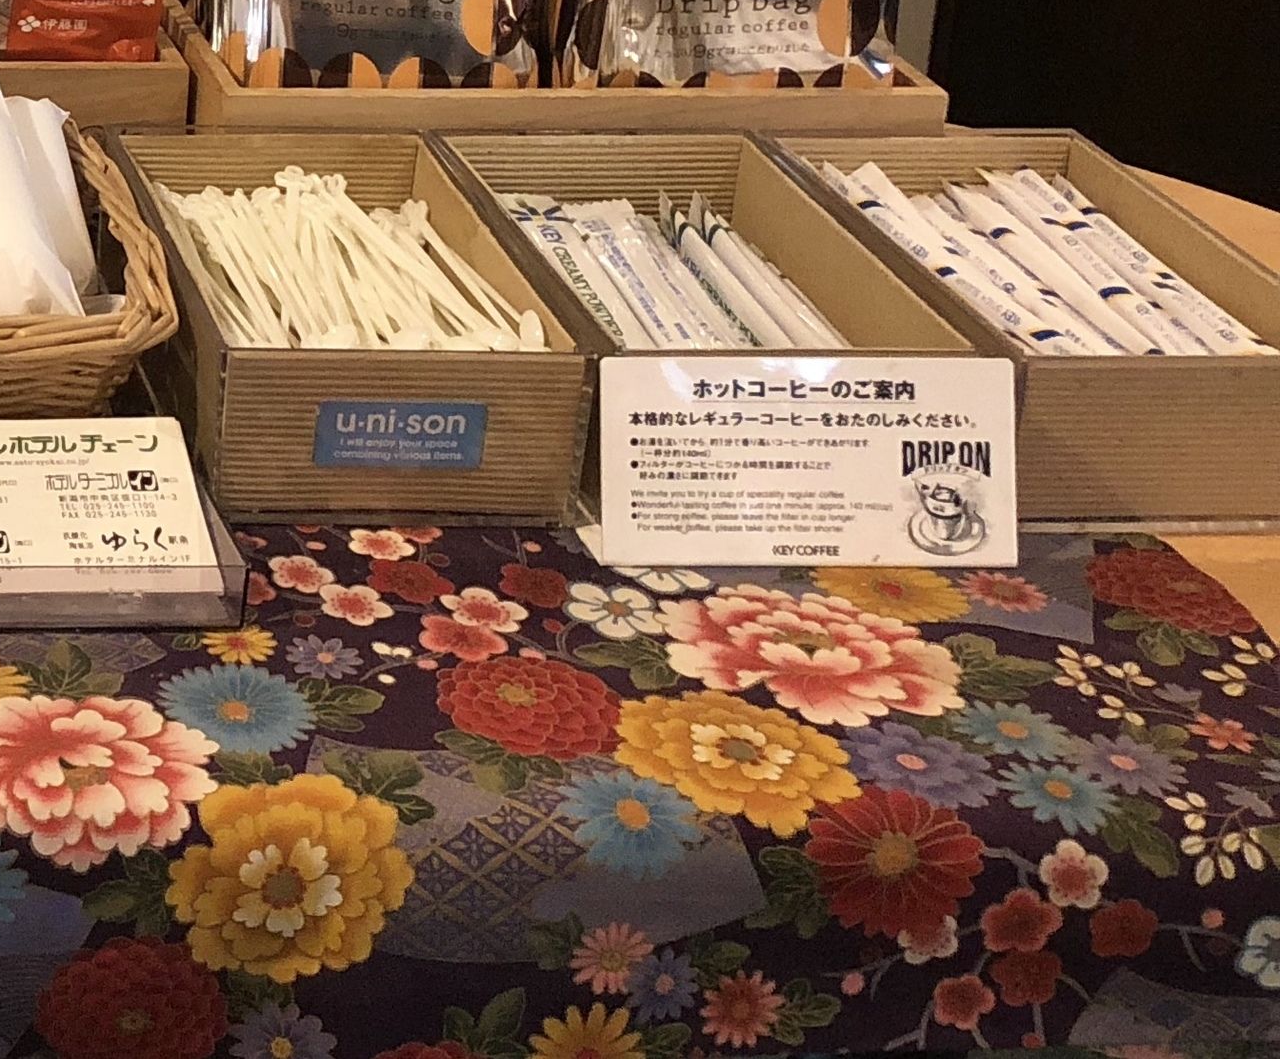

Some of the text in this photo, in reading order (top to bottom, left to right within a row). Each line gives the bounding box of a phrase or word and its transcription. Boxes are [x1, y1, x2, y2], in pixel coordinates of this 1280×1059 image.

[300, 0, 454, 21] regular coffee
[42, 18, 88, 32] 伊藤園
[655, 18, 810, 38] regular coffee
[552, 239, 591, 293] CREAMY
[692, 378, 917, 401] ホットコーヒーのご案内
[628, 411, 977, 428] 本格的なレギュラーコーヒーをおたのしみください。
[901, 440, 993, 478] DRIP ON
[60, 502, 79, 511] TEL
[61, 511, 80, 519] FAX
[101, 526, 169, 552] ゆらく
[796, 545, 840, 556] COFFEE
